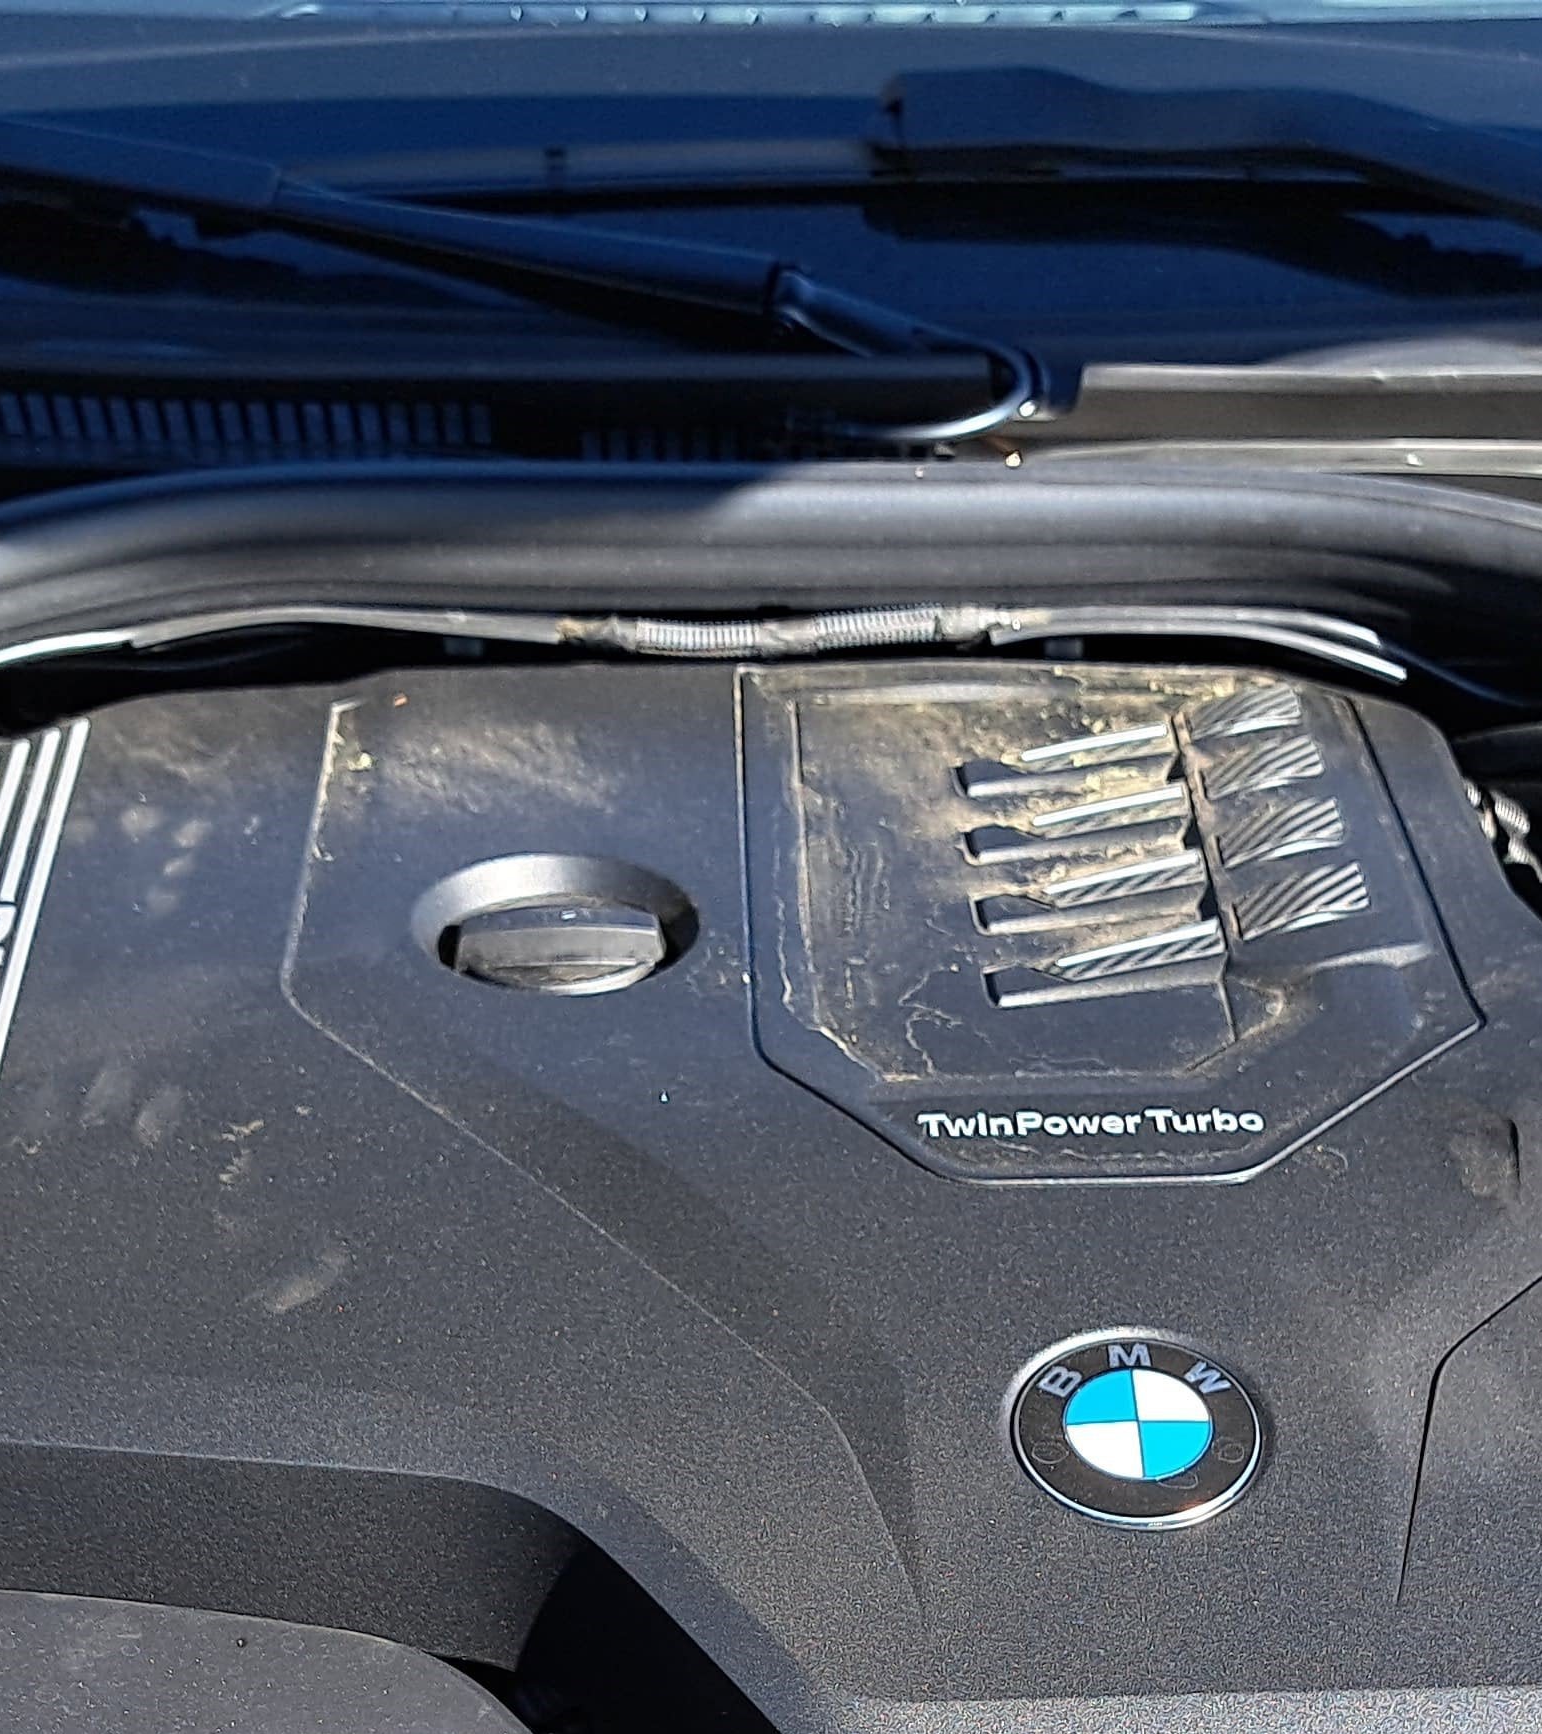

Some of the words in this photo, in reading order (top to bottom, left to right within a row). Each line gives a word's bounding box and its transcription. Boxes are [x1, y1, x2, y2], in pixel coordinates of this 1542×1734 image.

[917, 1110, 1141, 1138] TwinPower
[1144, 1107, 1265, 1134] Turbo
[1037, 1343, 1232, 1398] BMW
